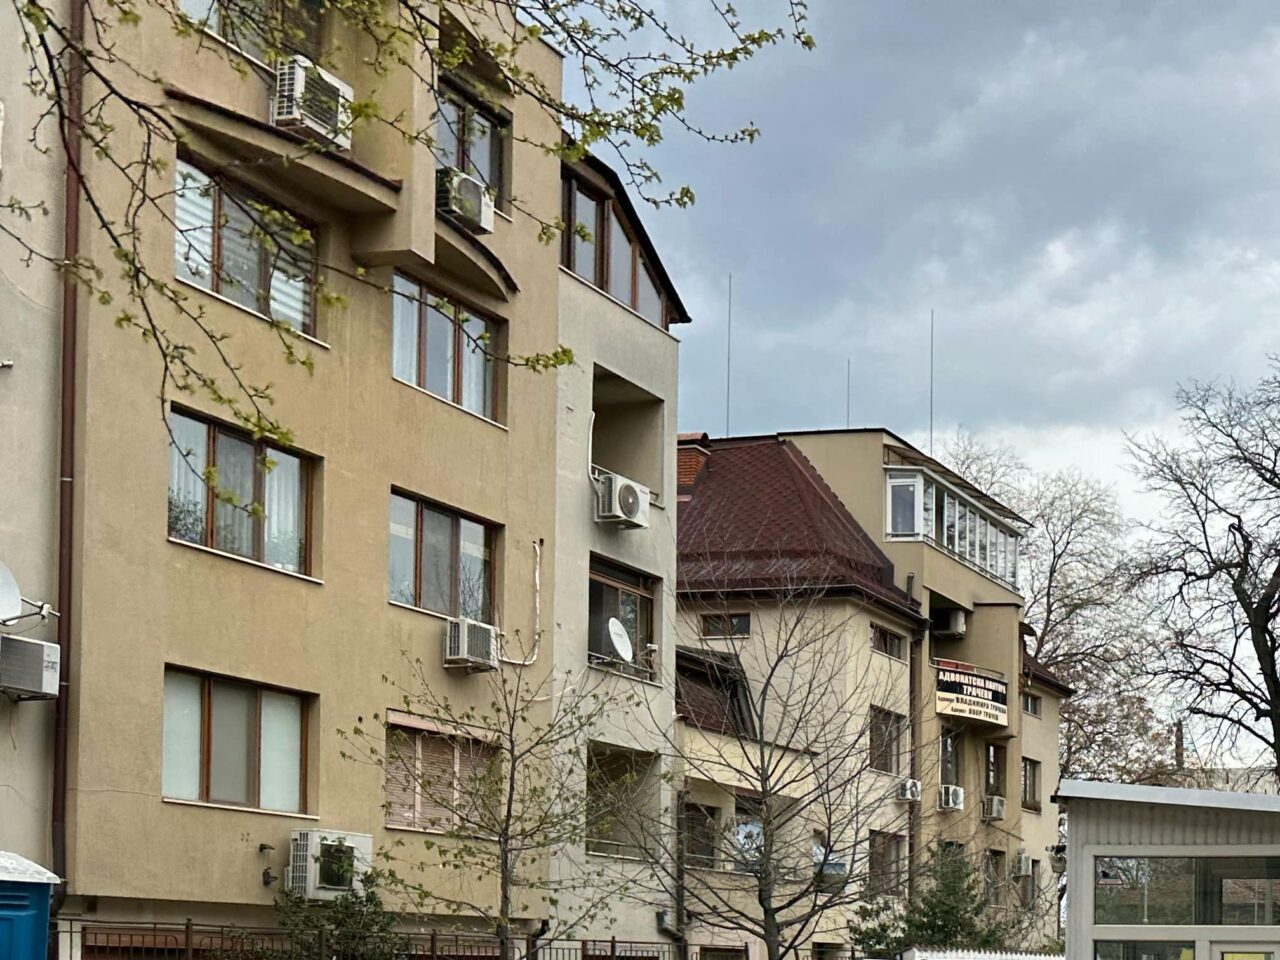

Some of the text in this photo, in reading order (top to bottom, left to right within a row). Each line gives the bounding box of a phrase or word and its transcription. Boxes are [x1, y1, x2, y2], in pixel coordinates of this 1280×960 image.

[939, 671, 1006, 694] АДВОКАТСКА КАНТОРА
[962, 685, 993, 700] ТРАЧЕВИ
[955, 696, 990, 710] ВЛАДИМИРА
